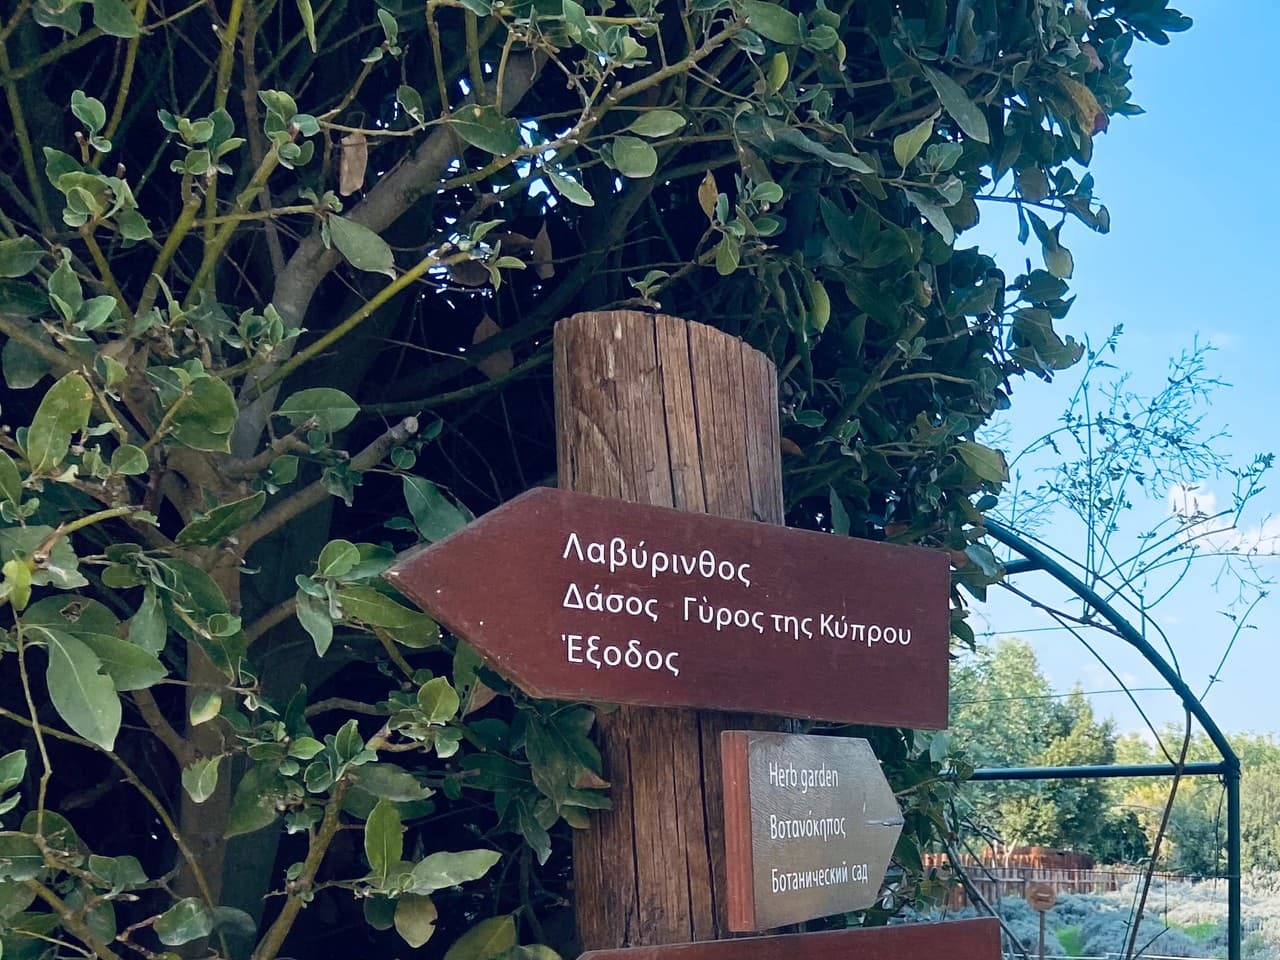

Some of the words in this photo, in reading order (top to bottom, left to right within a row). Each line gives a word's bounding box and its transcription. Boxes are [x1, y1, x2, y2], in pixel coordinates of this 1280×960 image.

[562, 531, 752, 588] Λαβύρινθος
[562, 582, 659, 622] Δάσος
[770, 612, 814, 641] της
[819, 613, 912, 647] Κύπρου
[561, 633, 680, 677] Έξοδος
[768, 761, 798, 787] Herb
[801, 762, 839, 794] garden
[769, 809, 846, 842] Βοτανόκηπος
[771, 860, 848, 893] Ботанический
[851, 862, 869, 884] сад
